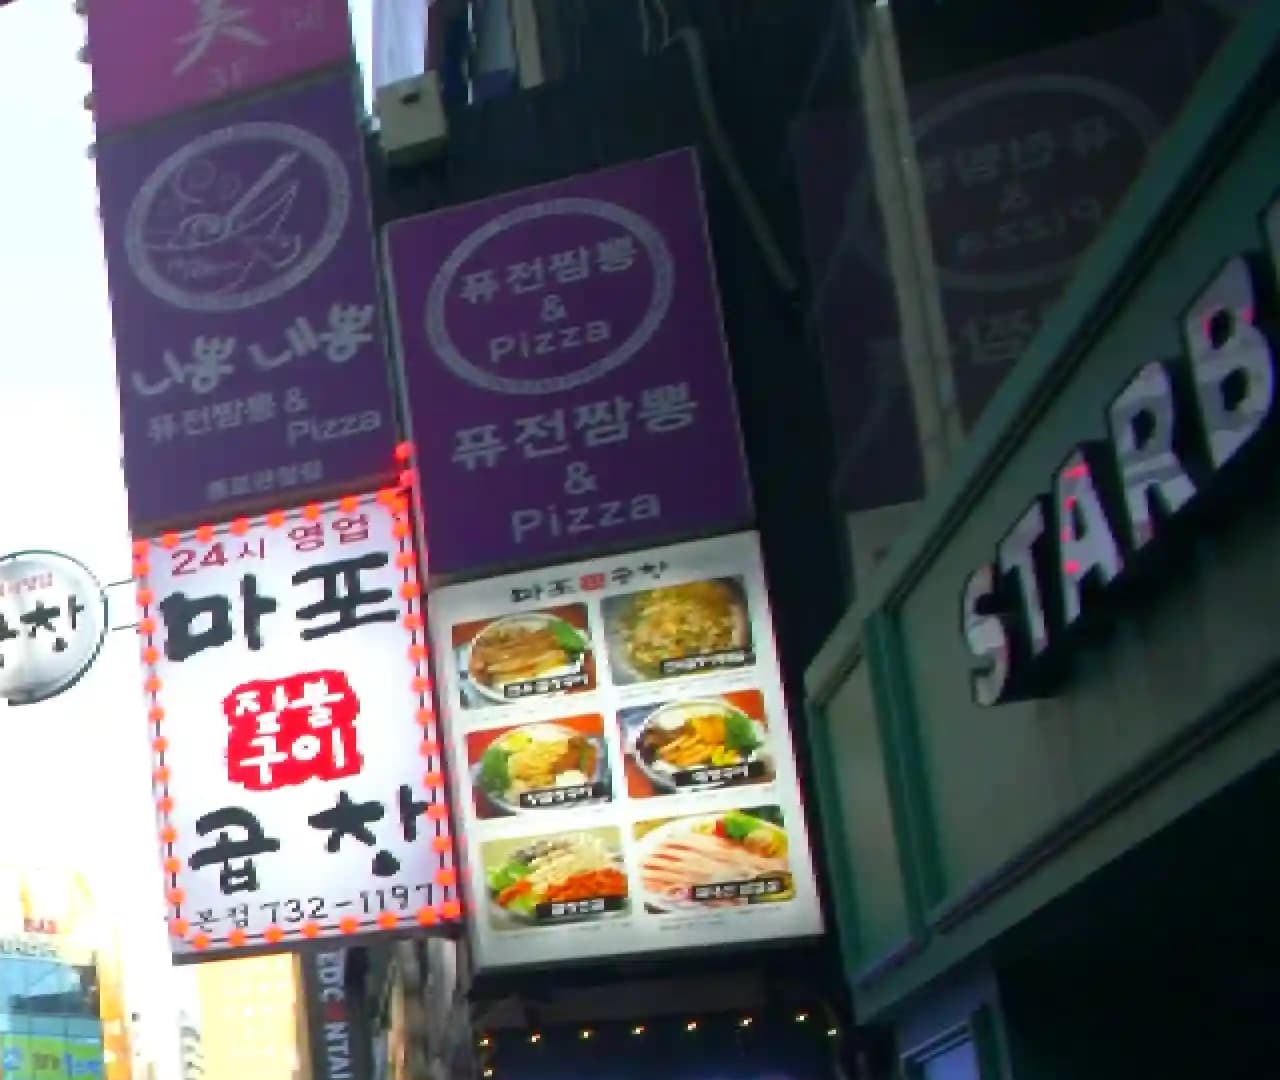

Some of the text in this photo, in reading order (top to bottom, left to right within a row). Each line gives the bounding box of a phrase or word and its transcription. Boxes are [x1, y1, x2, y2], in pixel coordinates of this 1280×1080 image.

[458, 235, 638, 304] 퓨전짬뽕
[489, 320, 611, 363] Pizza
[287, 409, 382, 446] Pizza
[451, 382, 699, 470] 퓨전짬뽕
[962, 190, 1280, 707] STARB
[563, 464, 598, 496] &
[169, 513, 370, 577] 24시 영업
[512, 492, 662, 544] Pizza
[159, 552, 401, 662] 마포
[187, 784, 432, 895] 곱창
[260, 883, 433, 923] 732-1197
